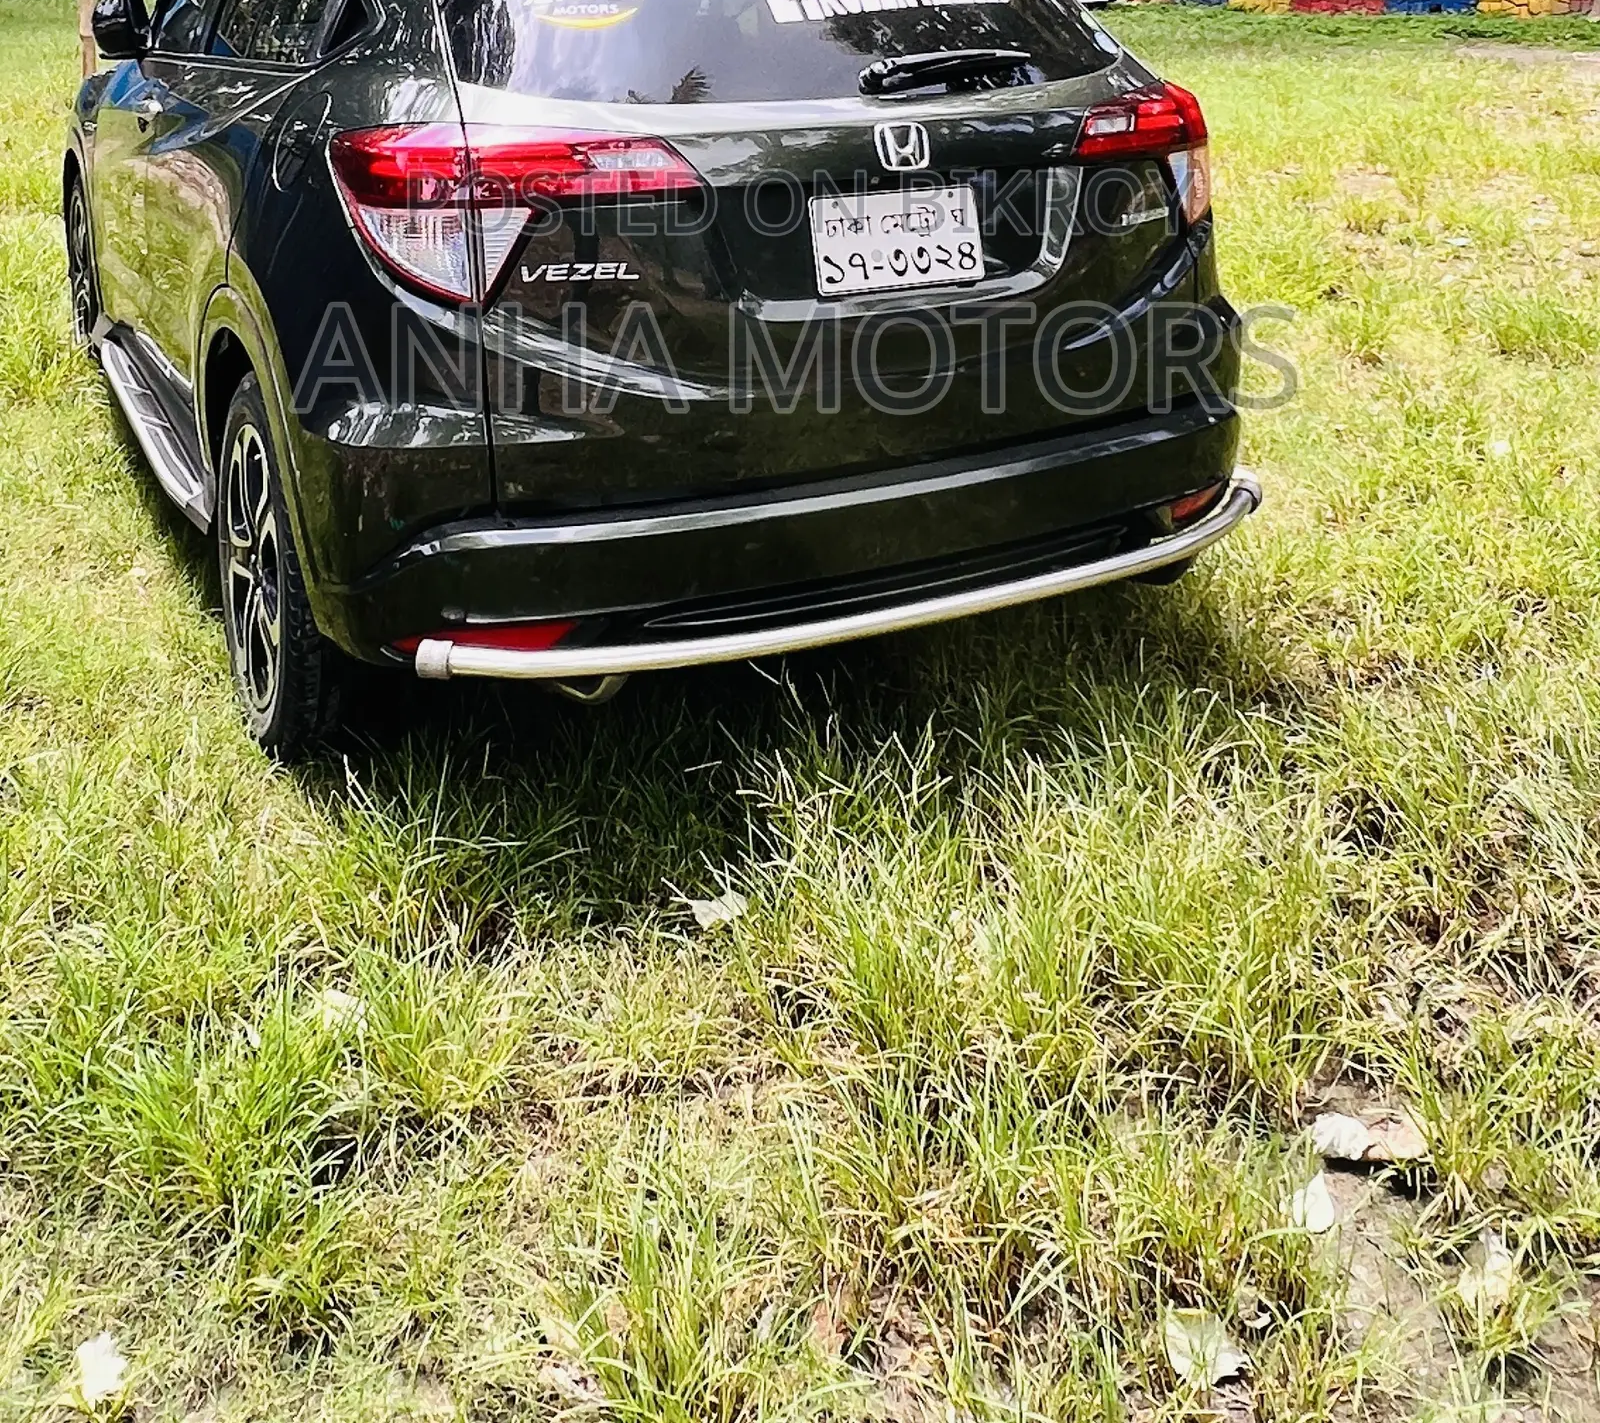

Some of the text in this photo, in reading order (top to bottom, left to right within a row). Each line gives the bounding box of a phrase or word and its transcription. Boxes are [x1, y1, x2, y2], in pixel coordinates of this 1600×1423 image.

[552, 3, 620, 16] MOTORS
[825, 214, 872, 238] ঢাকা
[880, 206, 936, 238] মেট্রো
[520, 262, 640, 283] VEZEL
[823, 241, 977, 284] ১৭-৩৩২৪
